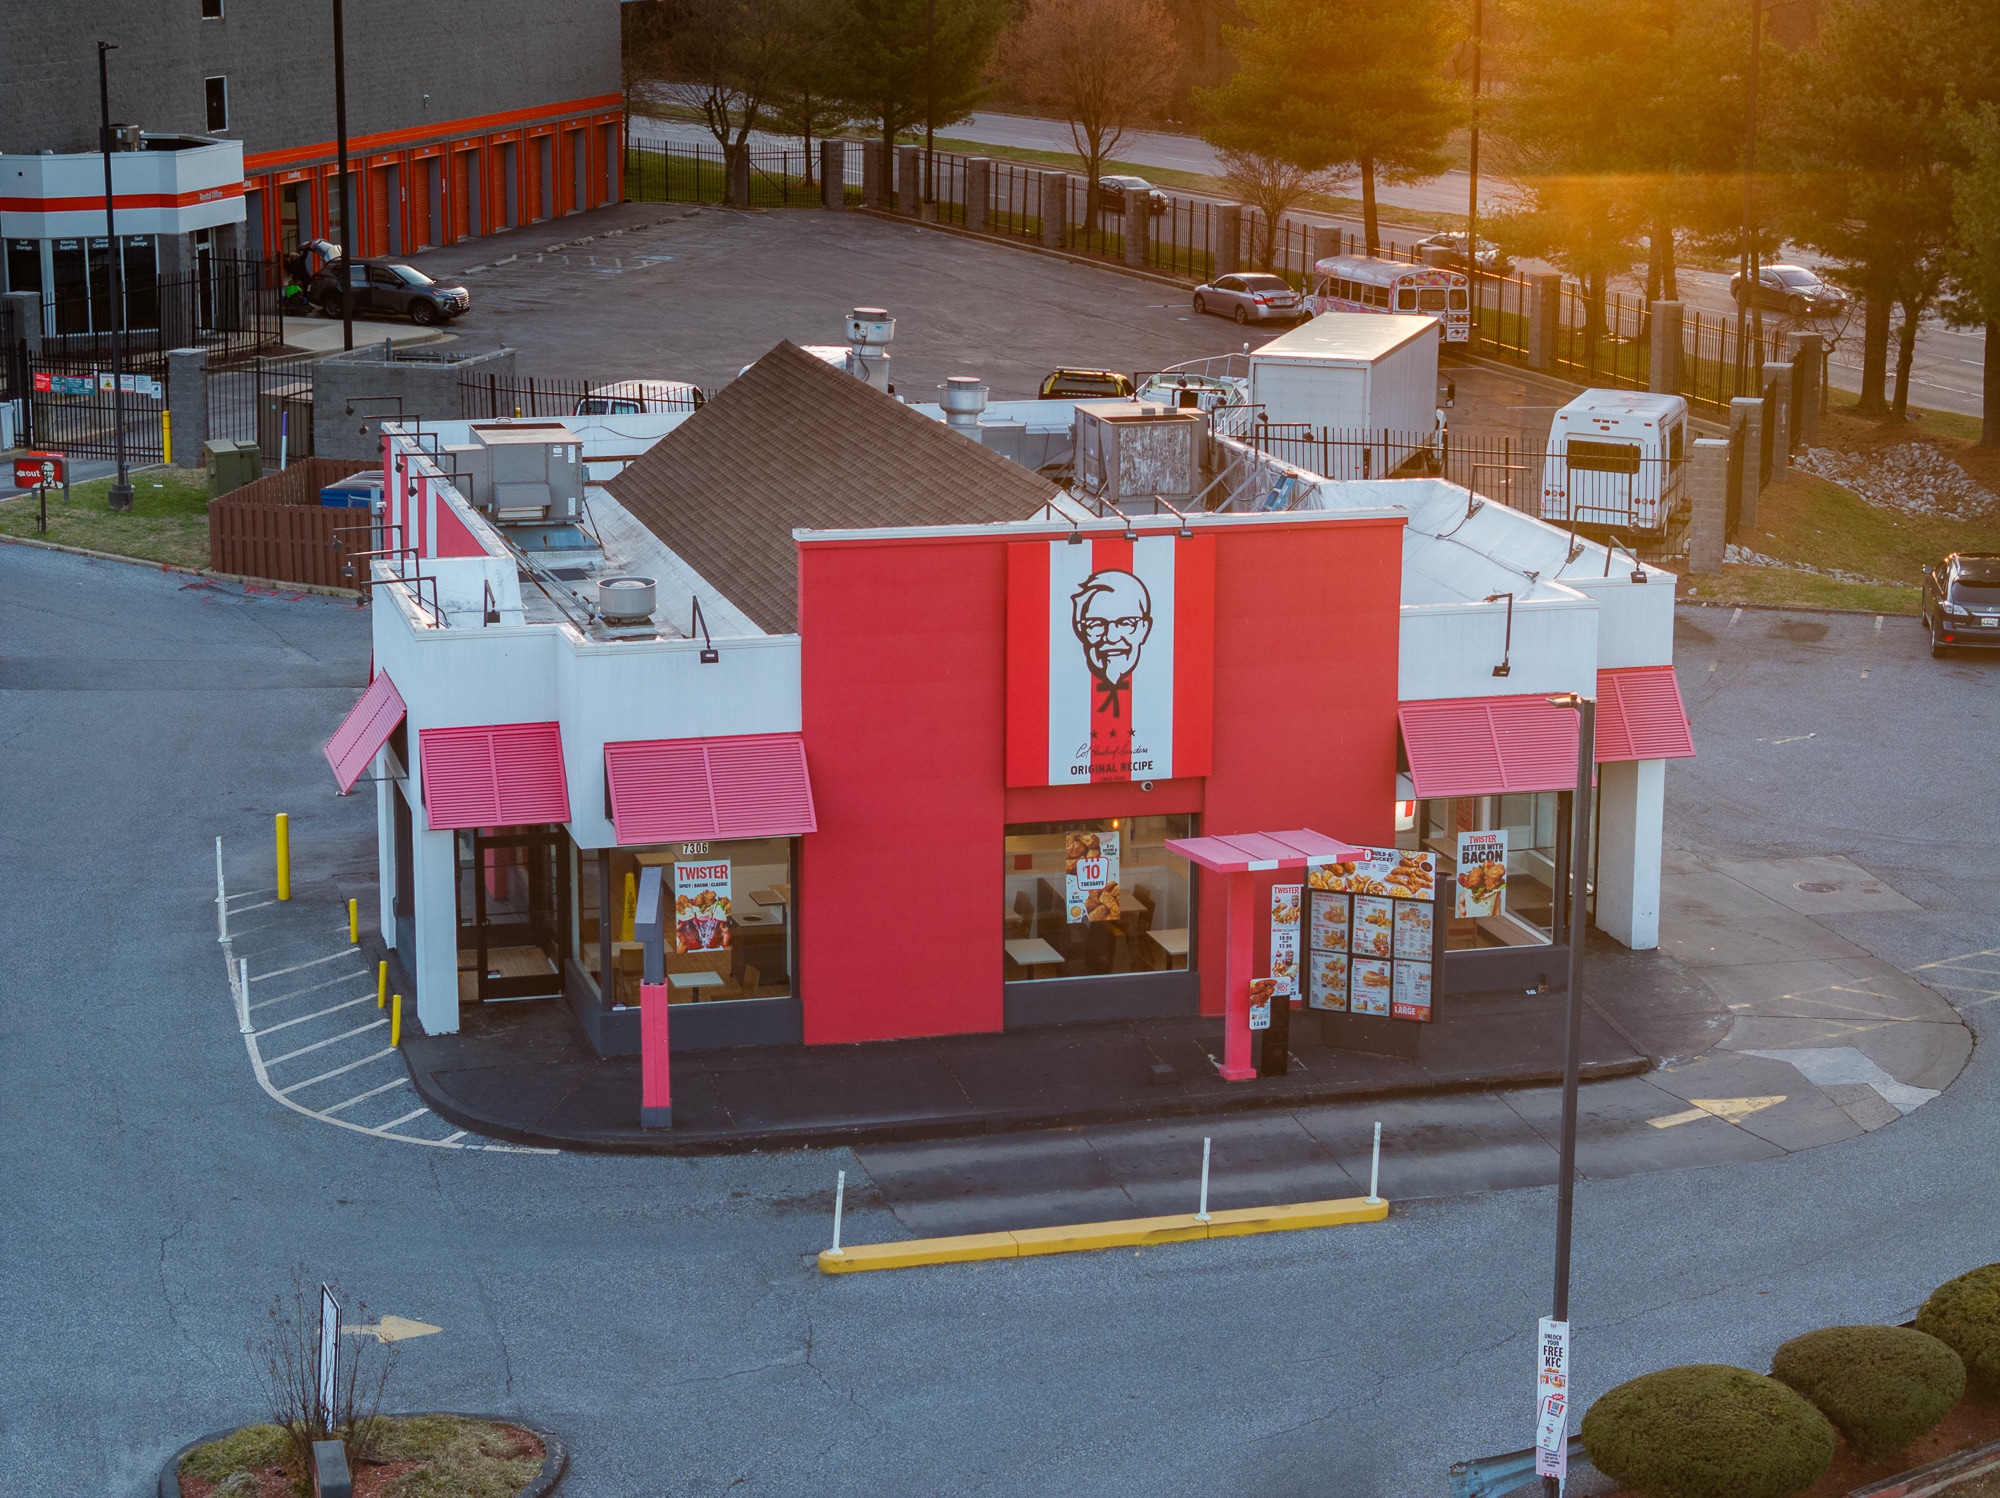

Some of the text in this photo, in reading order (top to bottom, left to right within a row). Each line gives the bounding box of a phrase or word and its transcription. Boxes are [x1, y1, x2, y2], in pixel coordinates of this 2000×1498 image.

[212, 190, 223, 198] Office
[1070, 760, 1154, 776] ORIGINAL RECIPE
[1469, 834, 1497, 844] TWISTER
[684, 843, 708, 854] 7306
[1462, 850, 1503, 864] BACON
[677, 864, 729, 881] TWISTER
[1274, 886, 1299, 895] TWISTER
[1394, 1005, 1416, 1015] LARGE
[1544, 1333, 1562, 1341] UNLOCK
[1543, 1345, 1564, 1358] FREE
[1545, 1356, 1562, 1369] KFC
